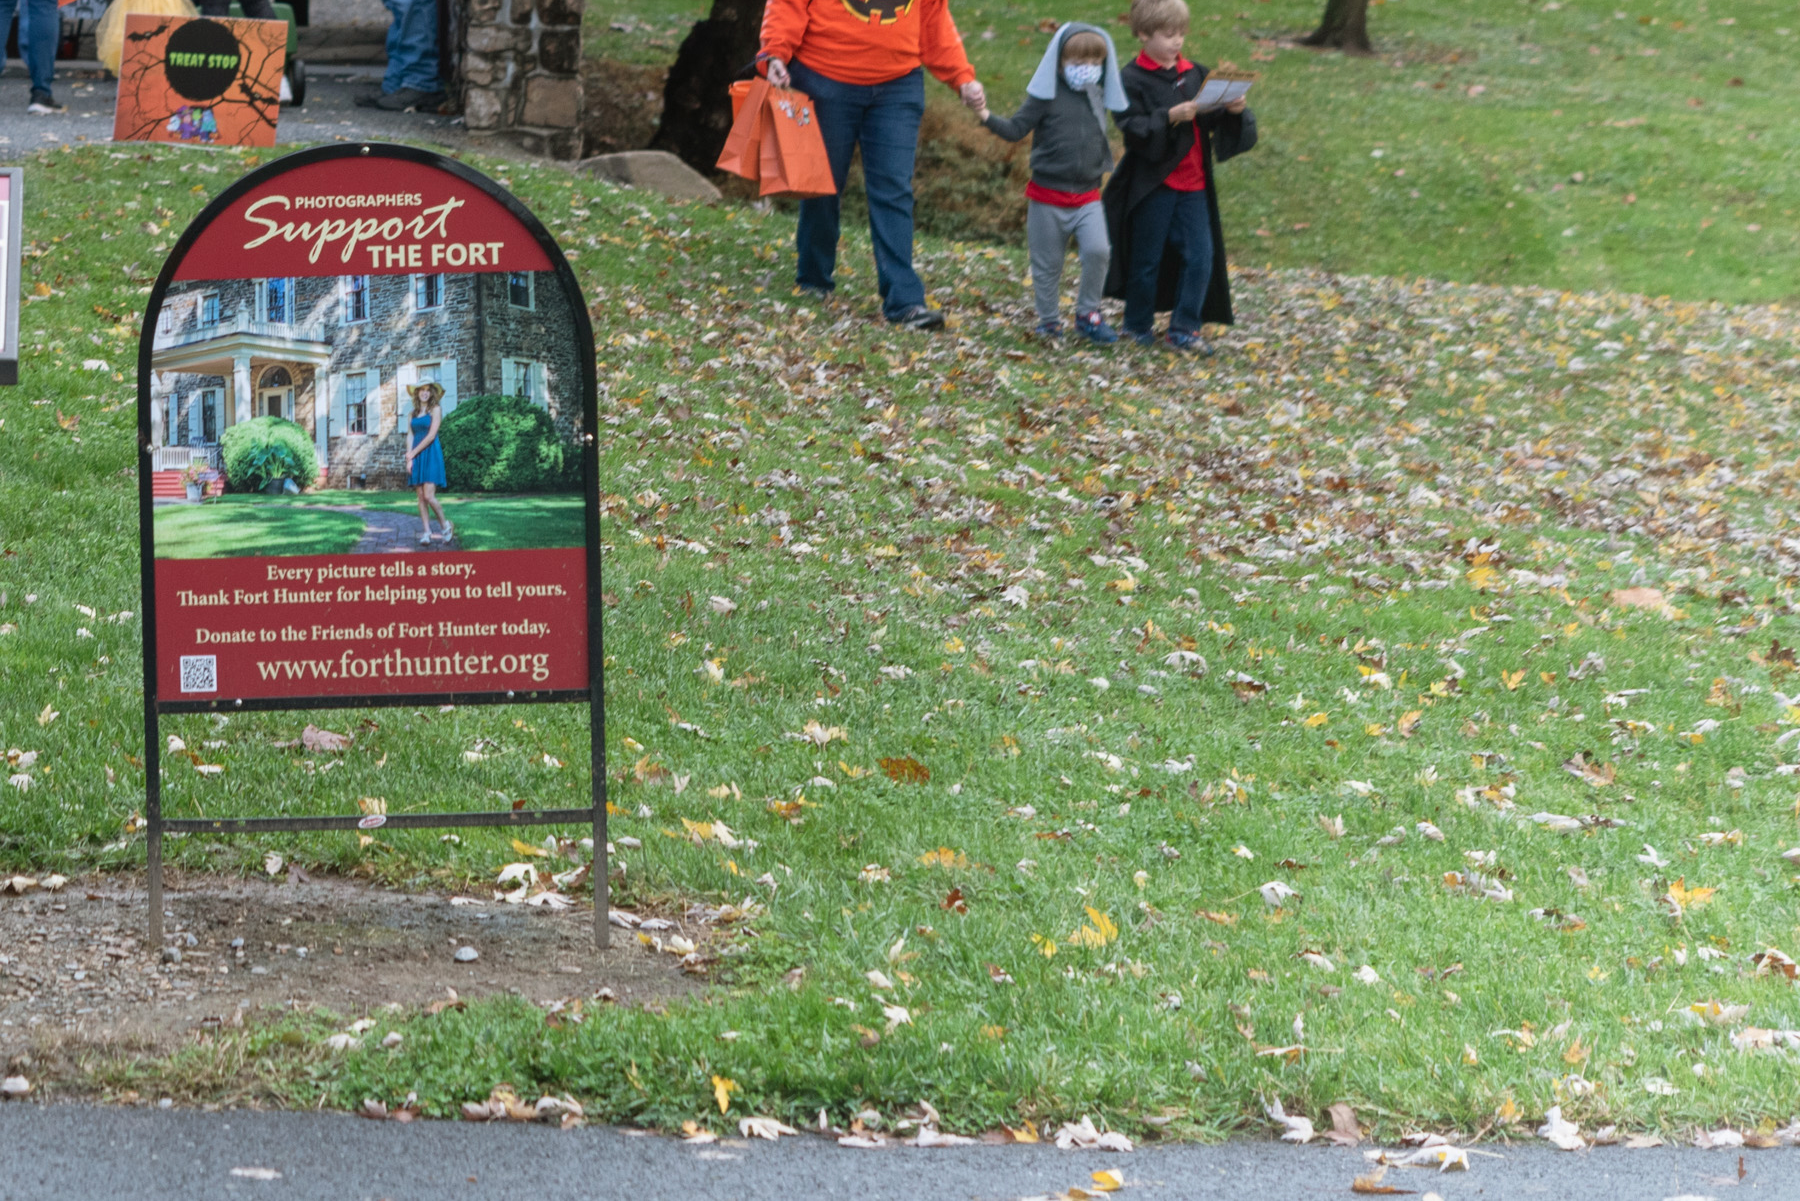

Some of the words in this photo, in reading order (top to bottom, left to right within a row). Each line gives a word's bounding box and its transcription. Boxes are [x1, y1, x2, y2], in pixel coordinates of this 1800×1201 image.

[169, 52, 205, 68] TREAT
[208, 53, 239, 69] STOP
[295, 193, 423, 209] PHOTOGRAPHERS
[243, 195, 466, 265] Support
[366, 244, 423, 268] THE
[431, 242, 505, 267] FORT
[267, 564, 313, 583] Every
[317, 563, 376, 583] picture
[380, 561, 414, 578] tells
[417, 566, 427, 577] a
[431, 562, 477, 580] story.
[177, 589, 230, 607] Thank
[234, 588, 269, 605] Fort
[273, 587, 333, 604] Hunter
[336, 585, 361, 602] for
[365, 584, 427, 606] helping
[430, 586, 461, 604] you
[465, 585, 482, 599] to
[486, 582, 512, 599] tell
[516, 583, 567, 601] yours.
[196, 628, 256, 644] Donate
[260, 628, 276, 642] to
[281, 625, 307, 641] the
[311, 623, 373, 641] Friends
[377, 622, 397, 639] of
[399, 622, 433, 638] Fort
[438, 621, 498, 638] Hunter
[502, 619, 551, 638] today.
[257, 648, 550, 682] www.forthunter.org
